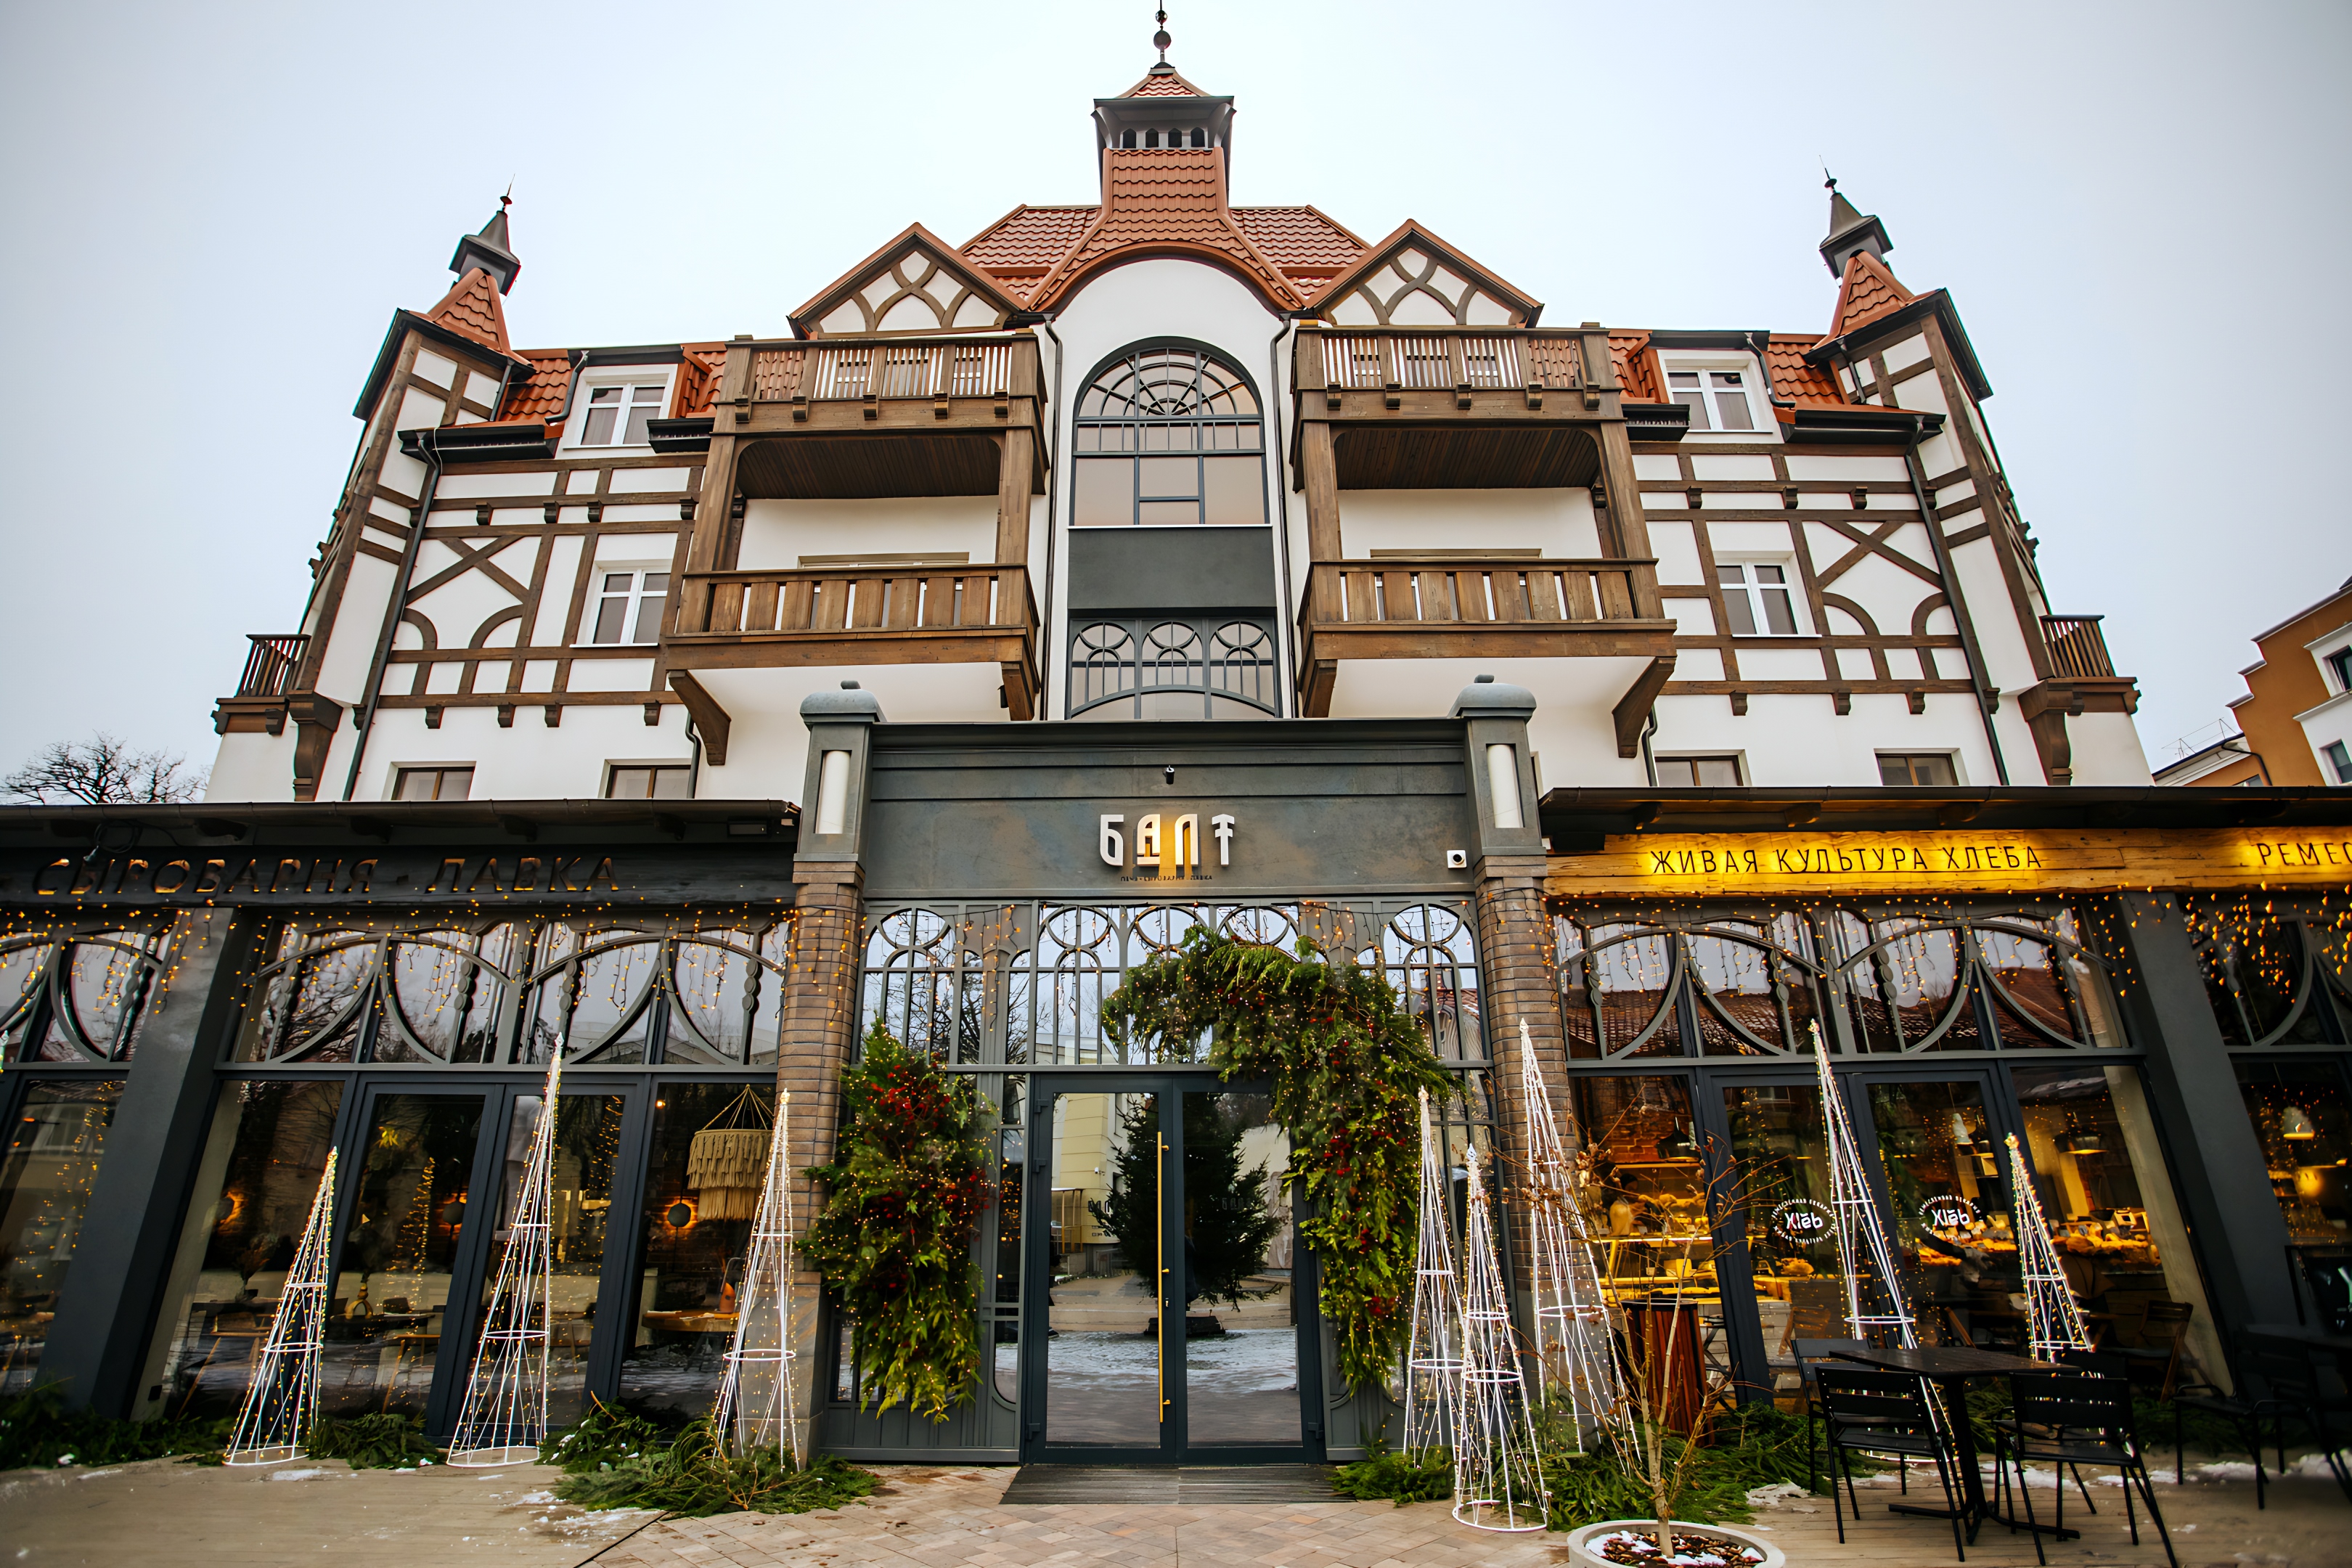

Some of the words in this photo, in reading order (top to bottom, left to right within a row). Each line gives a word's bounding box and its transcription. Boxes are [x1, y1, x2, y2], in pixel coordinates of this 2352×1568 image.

[1100, 813, 1235, 867] БАЛТ
[32, 857, 378, 895] СЫРОВАРНЯ
[425, 857, 619, 893] ЛАВКА
[1650, 849, 1758, 873] ЖИВАЯ
[1775, 847, 1928, 873] КУЛЬТУРА
[1943, 846, 2041, 869] ХЛЕБА
